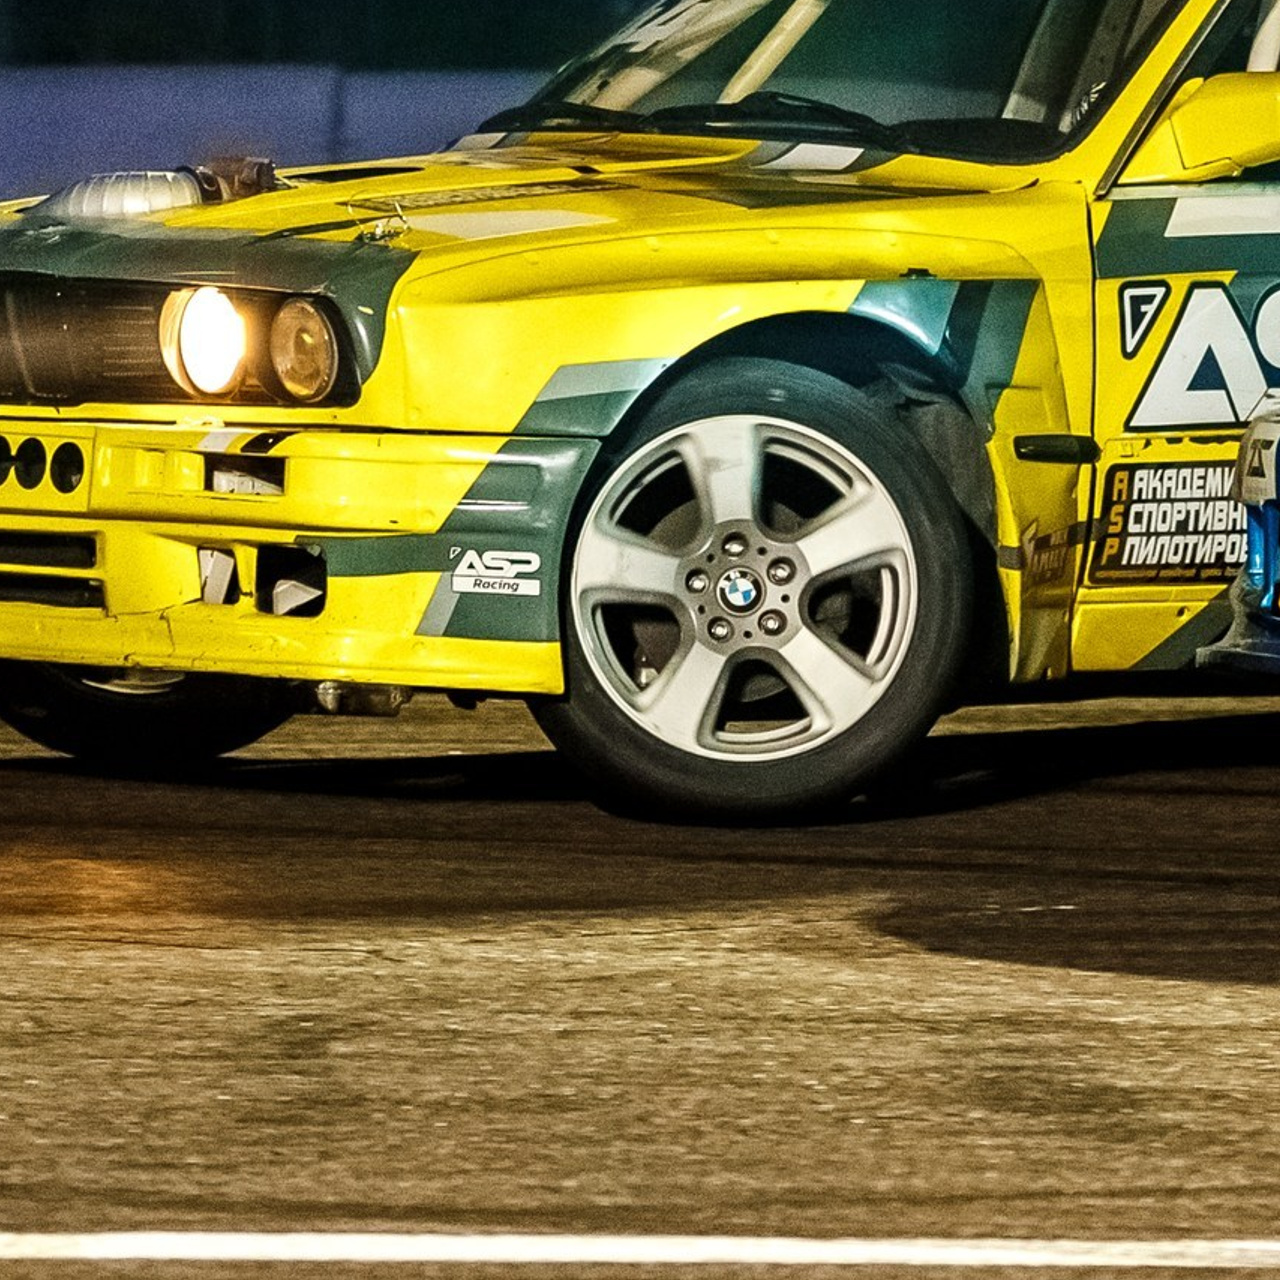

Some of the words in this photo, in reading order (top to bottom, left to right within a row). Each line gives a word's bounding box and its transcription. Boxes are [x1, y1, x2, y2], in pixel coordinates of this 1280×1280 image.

[1127, 500, 1248, 533] СПОРТИВН
[453, 549, 541, 578] ASP
[472, 578, 520, 592] Racing
